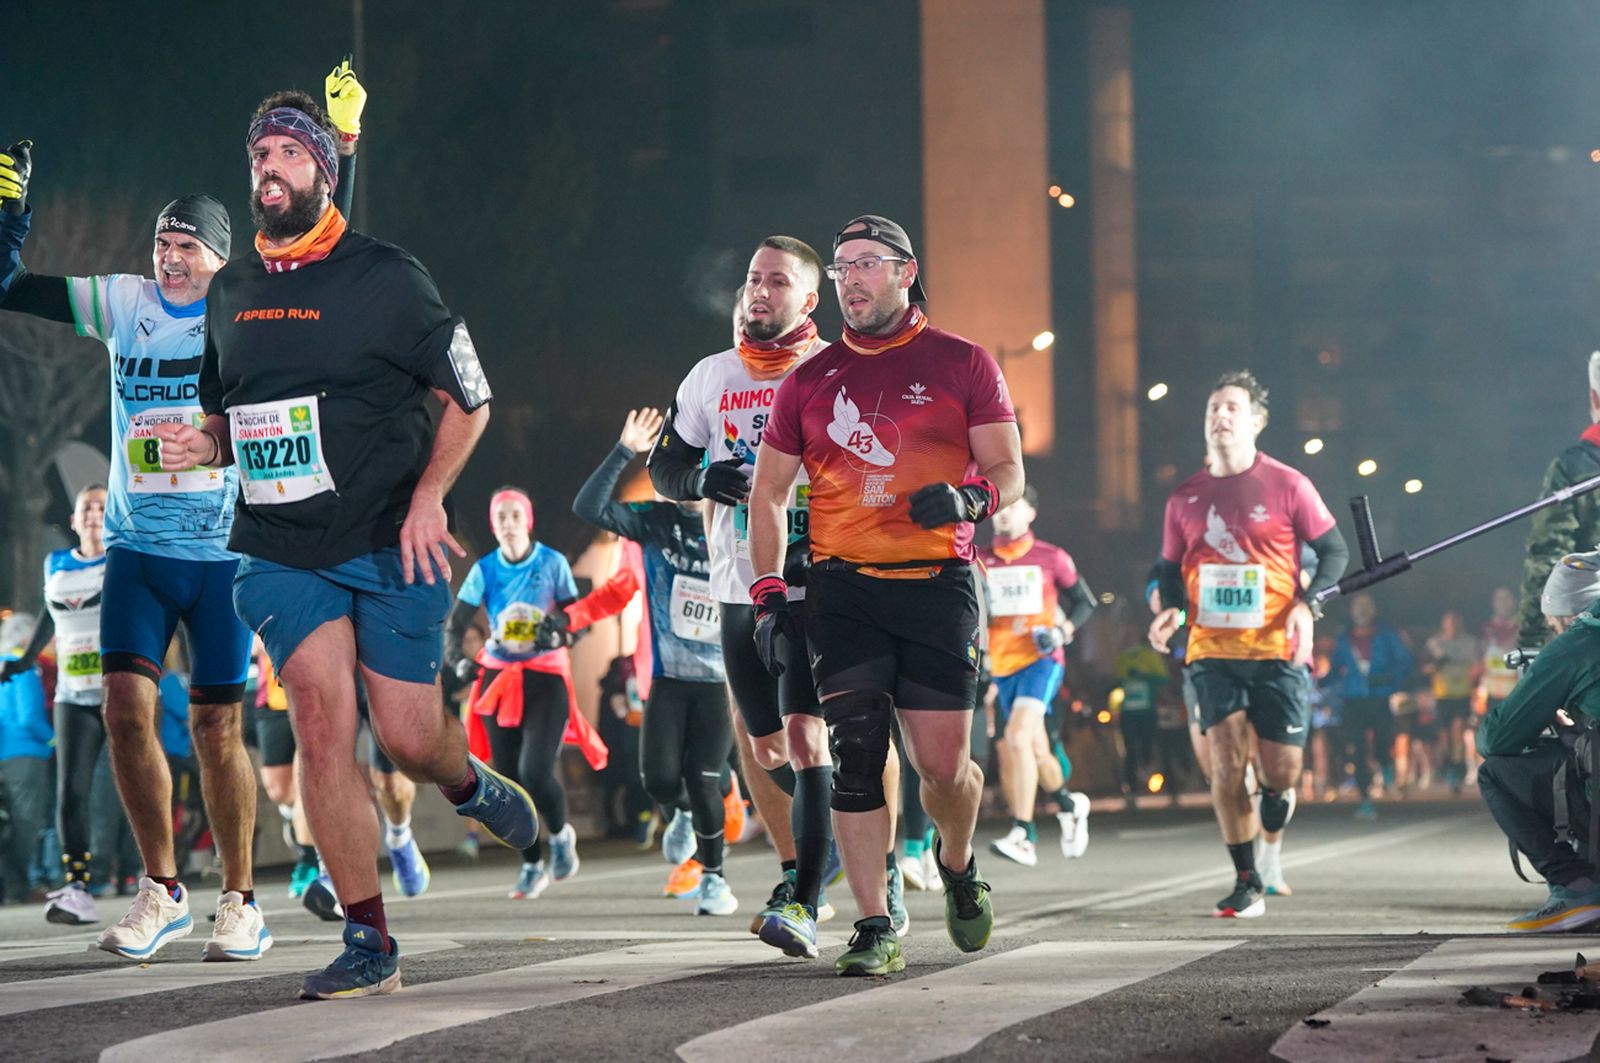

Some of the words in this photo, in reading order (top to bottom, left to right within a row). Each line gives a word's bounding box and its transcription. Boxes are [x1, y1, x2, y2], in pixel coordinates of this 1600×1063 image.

[287, 308, 321, 321] RUN
[718, 388, 775, 413] ÁNIMO
[243, 415, 268, 426] NOCHE
[269, 413, 280, 423] DE
[847, 430, 873, 454] 43
[242, 435, 311, 471] 13220
[863, 485, 884, 494] SAN
